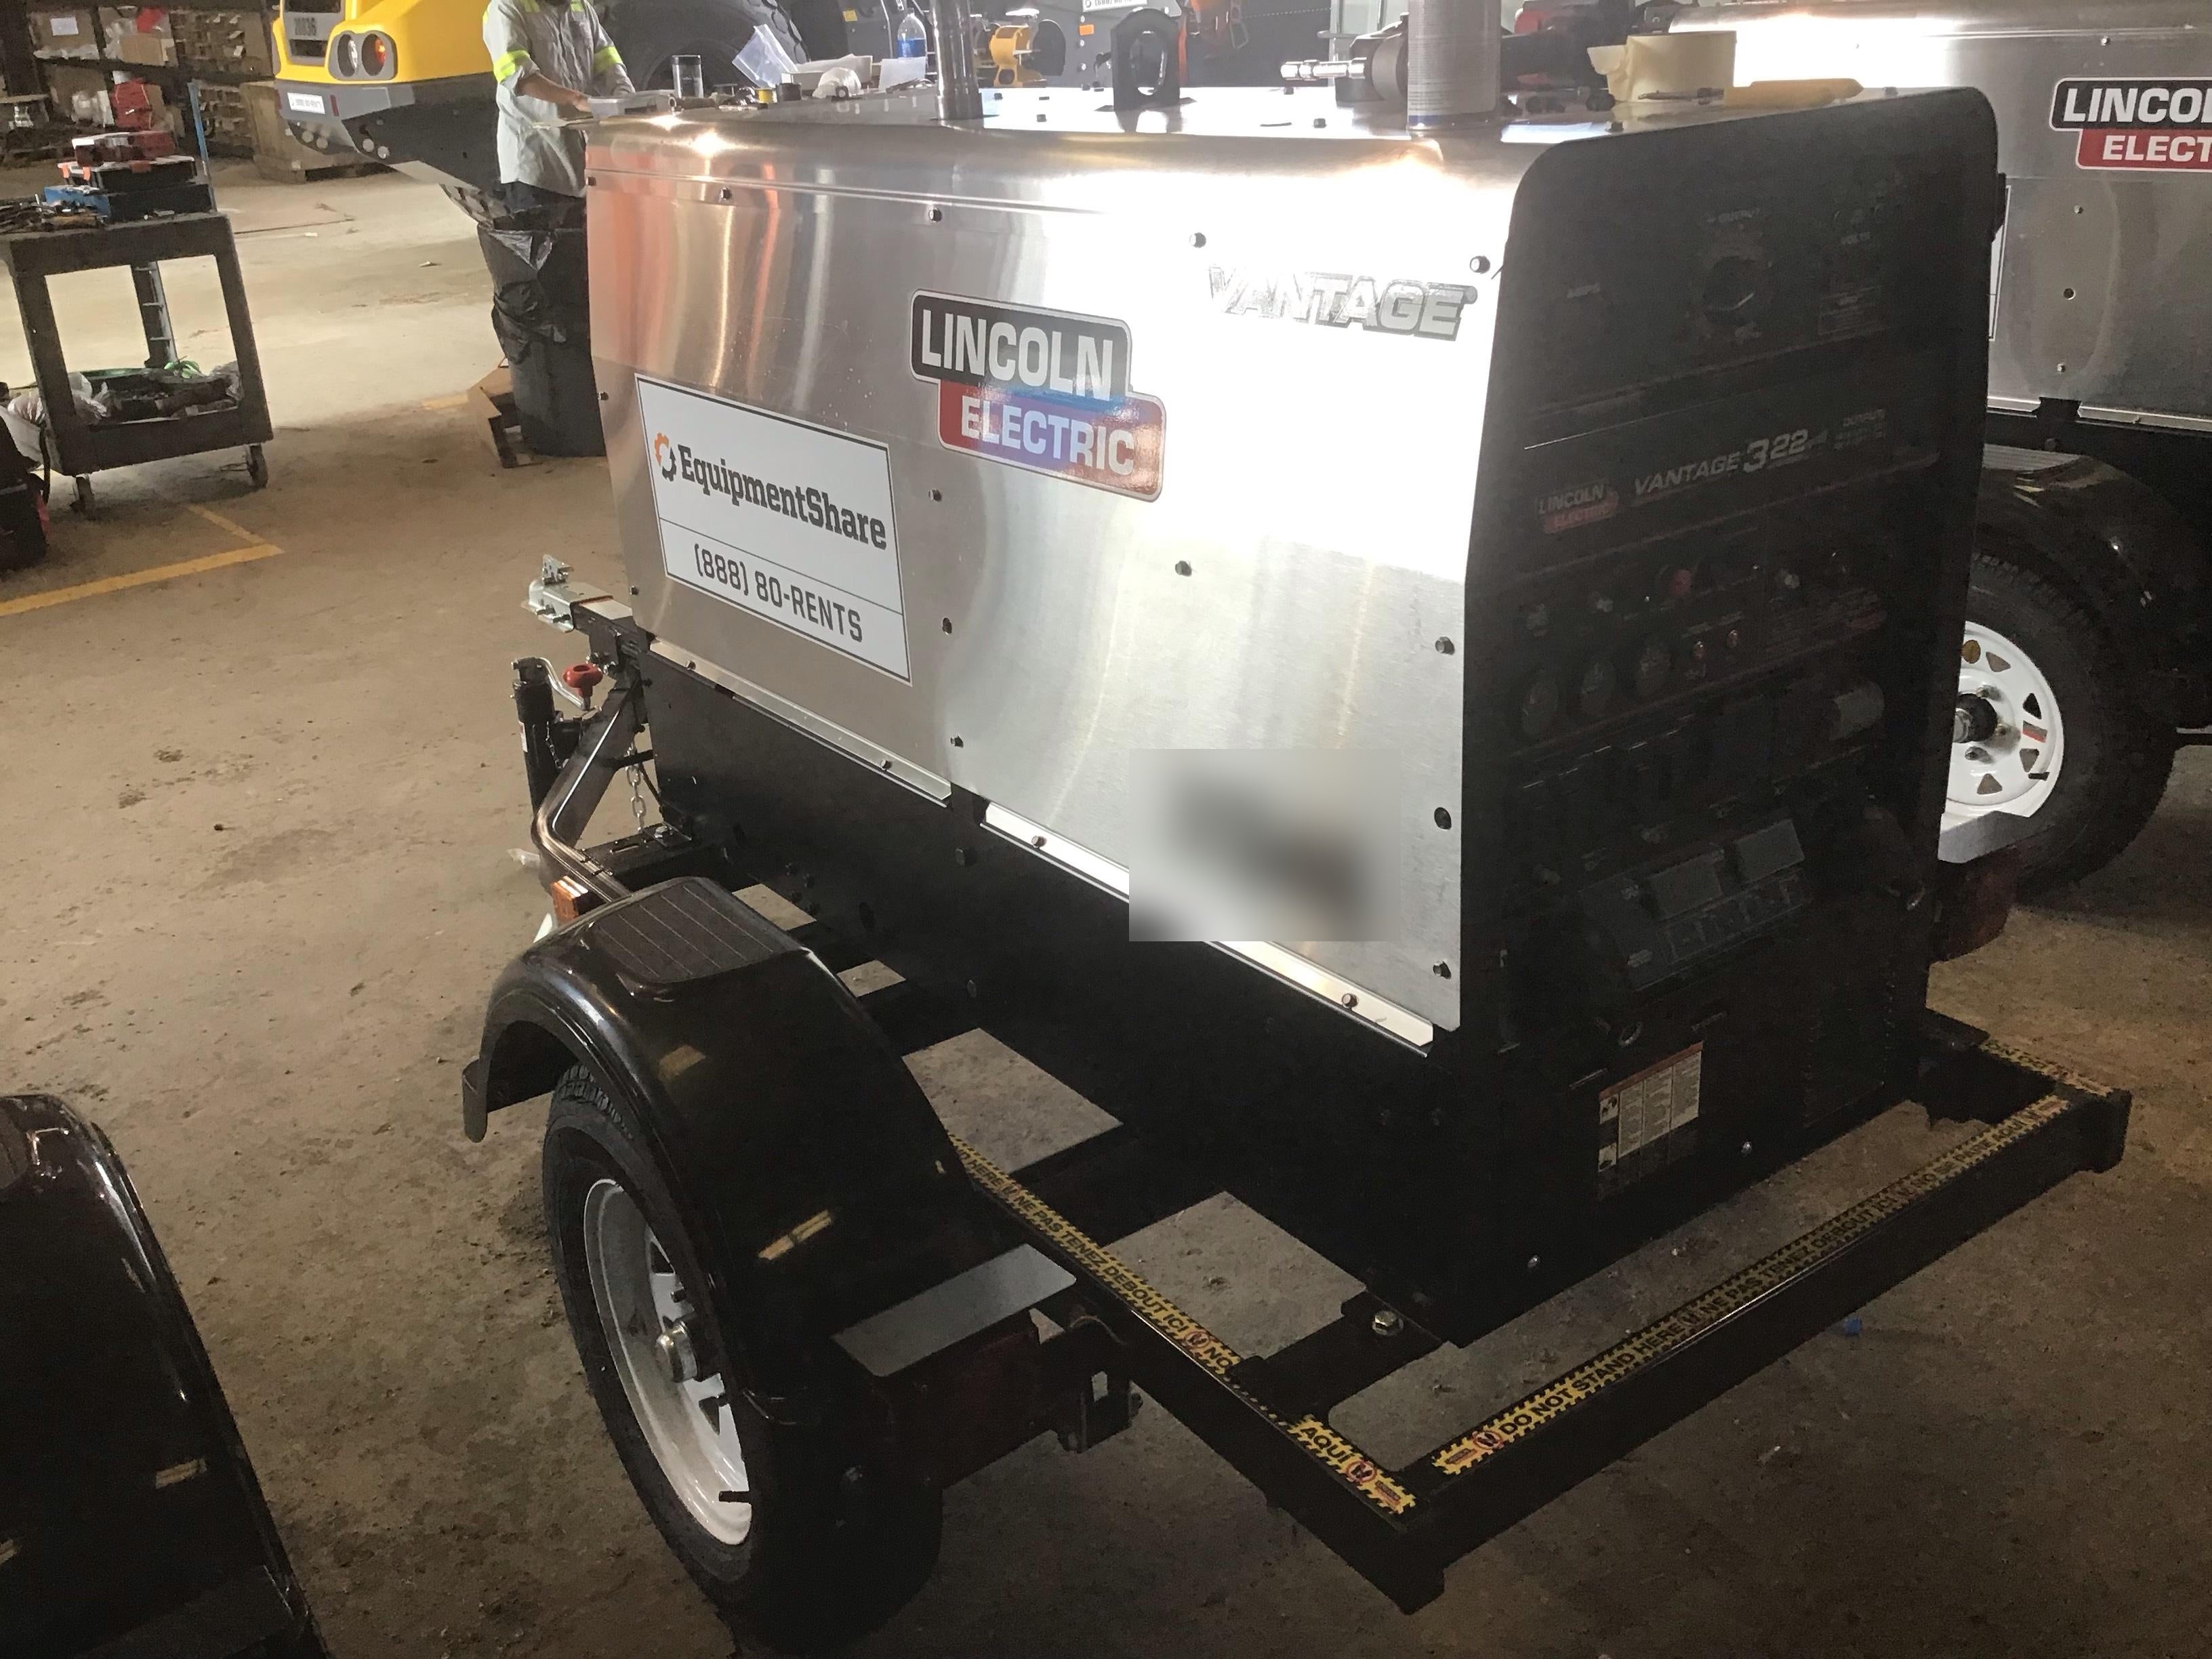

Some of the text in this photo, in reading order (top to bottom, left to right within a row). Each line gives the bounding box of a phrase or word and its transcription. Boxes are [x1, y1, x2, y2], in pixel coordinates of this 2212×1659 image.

[1209, 264, 1467, 342] VANTAGE
[922, 309, 1113, 401] LINCOLN
[961, 395, 1134, 476] ELECTRIC
[1634, 451, 1742, 495] VANTAGE
[1742, 428, 1809, 473] 322
[677, 445, 887, 550] EquipmentShare
[1538, 483, 1604, 515] LINCOLN
[694, 544, 863, 643] (888) 80-RENTS
[966, 1159, 1233, 1368] HERE NE PAS TENEZ DEBOUT ICI NO
[1499, 1414, 1532, 1435] DO
[1529, 1388, 1573, 1416] NOT
[1572, 1352, 1636, 1392] STAND
[1633, 1322, 1685, 1354] HERE
[1699, 1296, 1729, 1313] NE
[1724, 1277, 1763, 1300] PAS
[1810, 1209, 1874, 1248] DEBOUT
